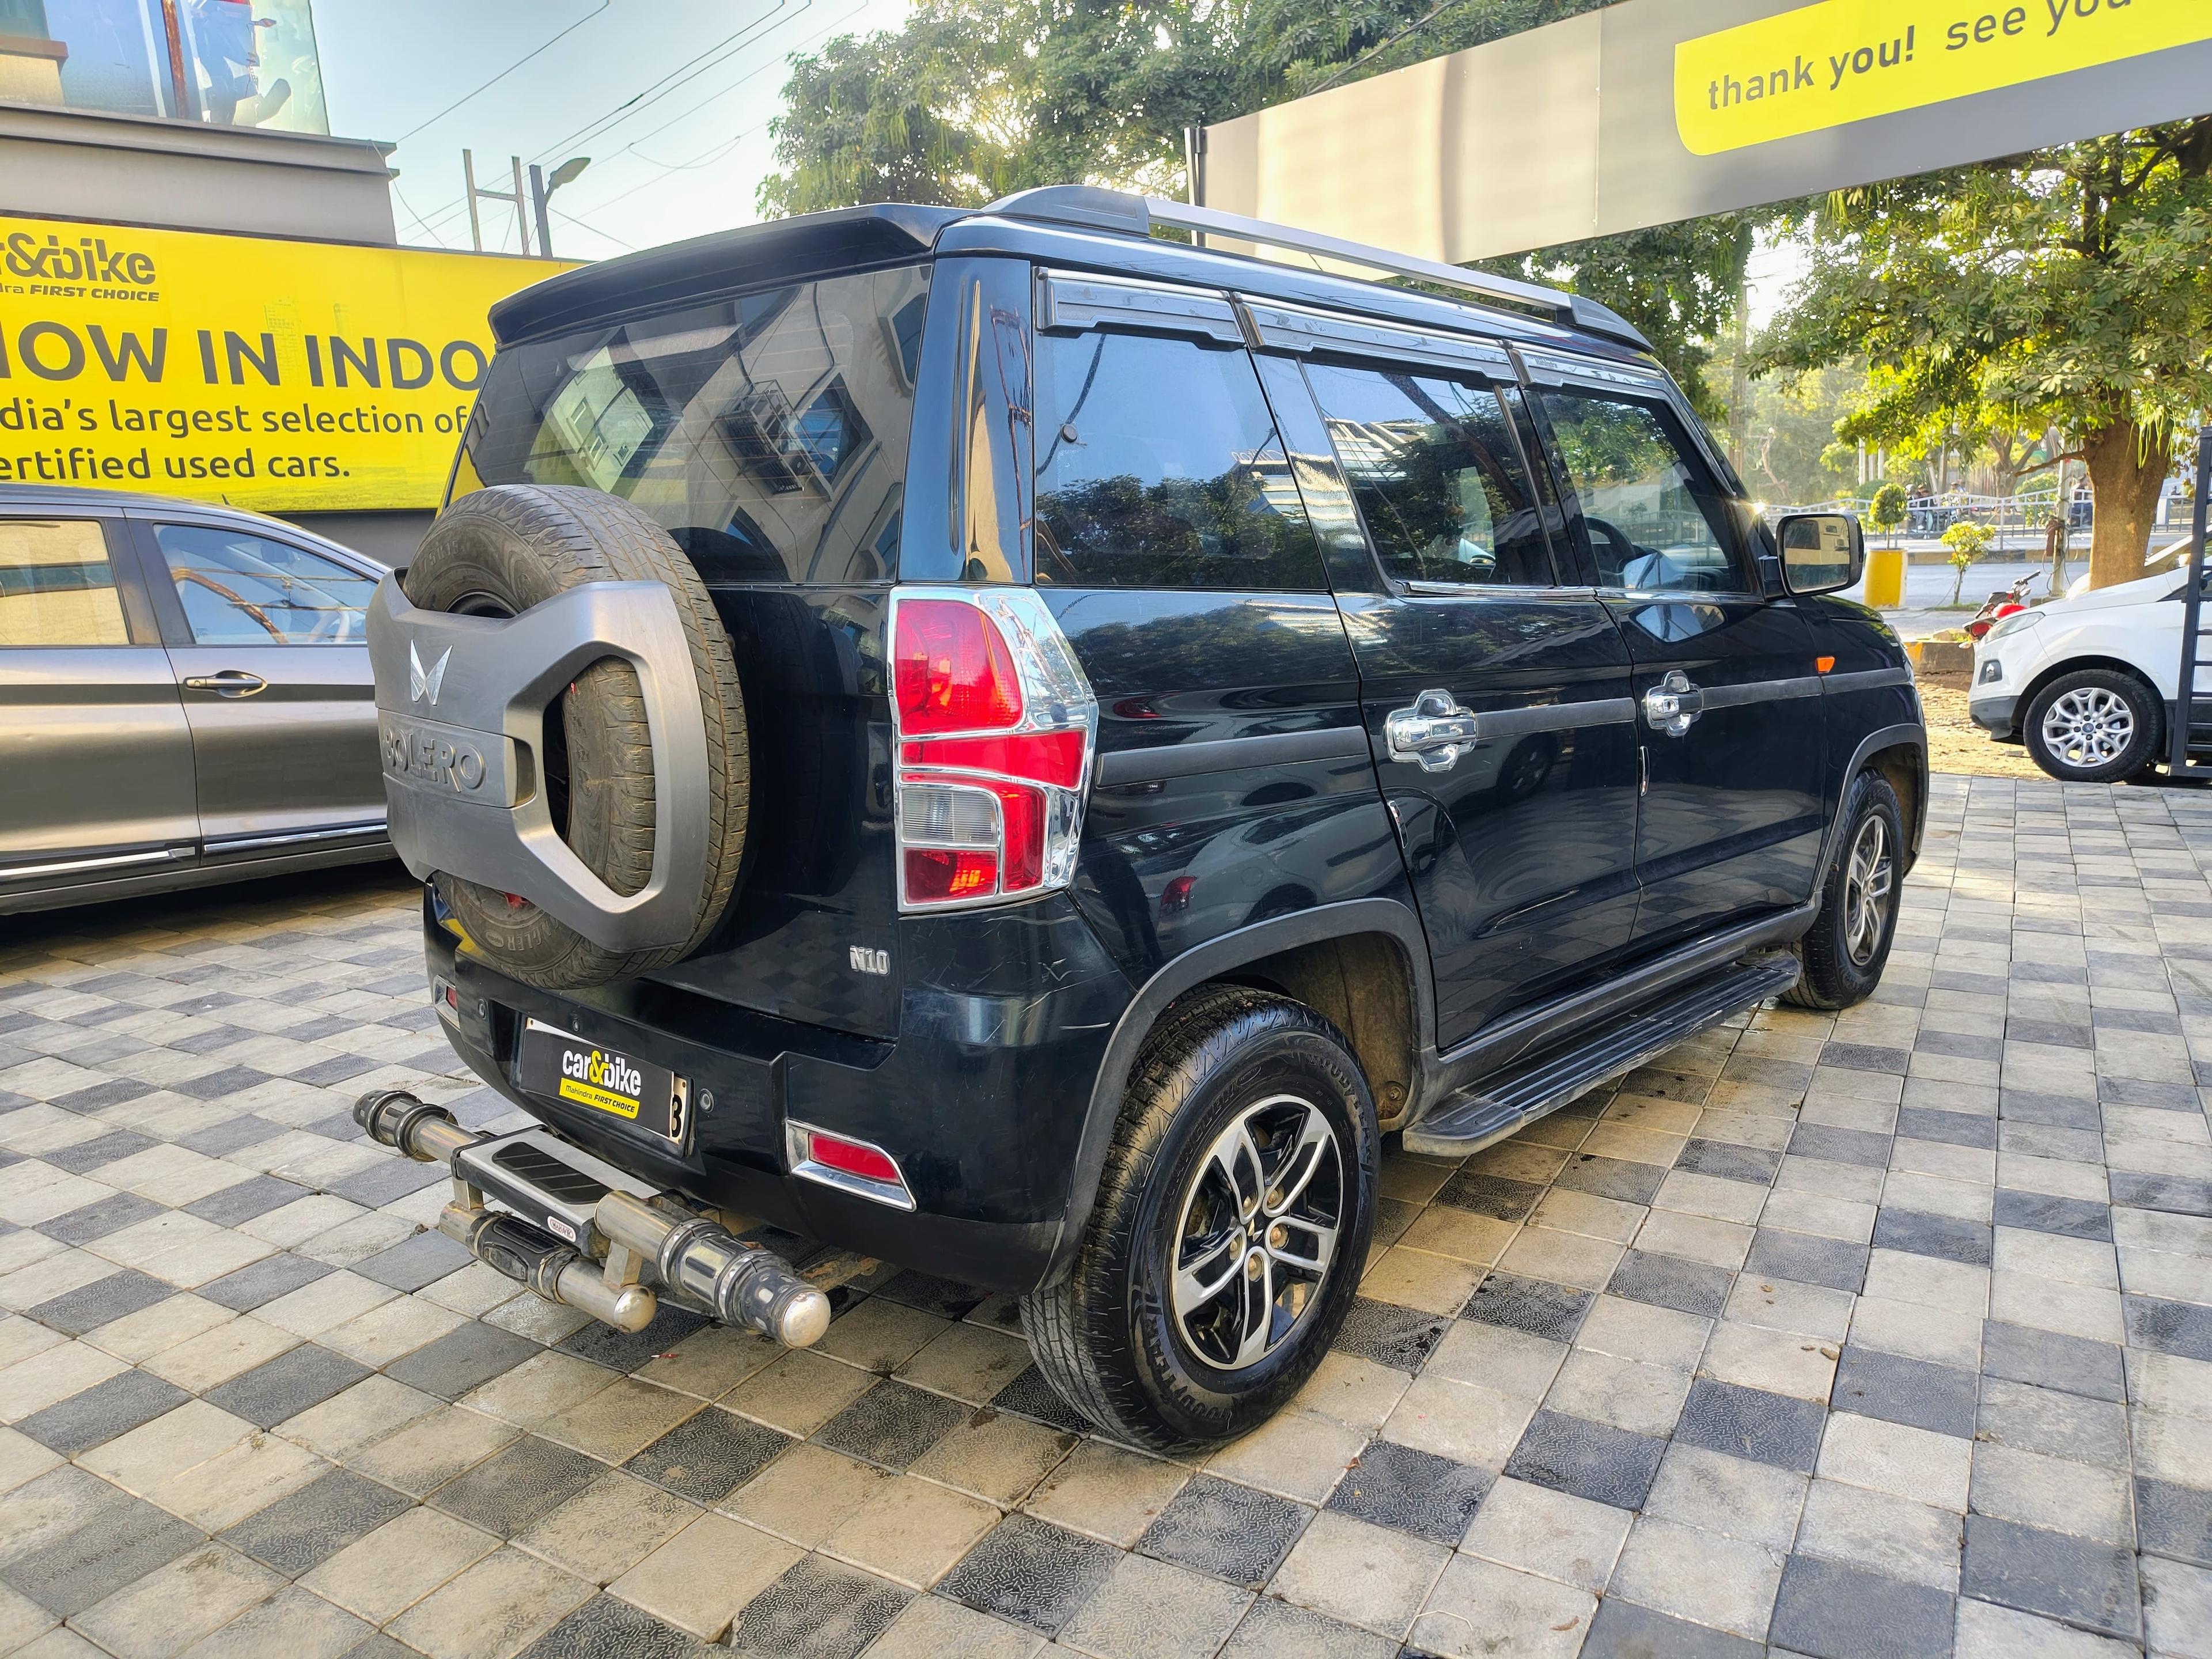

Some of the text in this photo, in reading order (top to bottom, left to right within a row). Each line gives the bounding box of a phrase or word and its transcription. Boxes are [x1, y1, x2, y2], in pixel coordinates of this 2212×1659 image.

[1709, 55, 1814, 110] thank
[1828, 25, 1915, 91] you!
[1945, 6, 2026, 51] see
[30, 285, 87, 298] FIRST
[91, 288, 160, 302] CHOICE
[0, 320, 488, 391] OW IN INDO
[109, 399, 252, 438] largest
[262, 403, 423, 433] selection
[434, 405, 467, 433] of
[165, 447, 255, 479] used
[268, 456, 350, 478] cars.
[382, 727, 485, 793] BOLERO
[850, 945, 891, 976] N10
[562, 1050, 641, 1096] car&bike
[566, 1085, 635, 1113] Mahindra FIRST CHOICE
